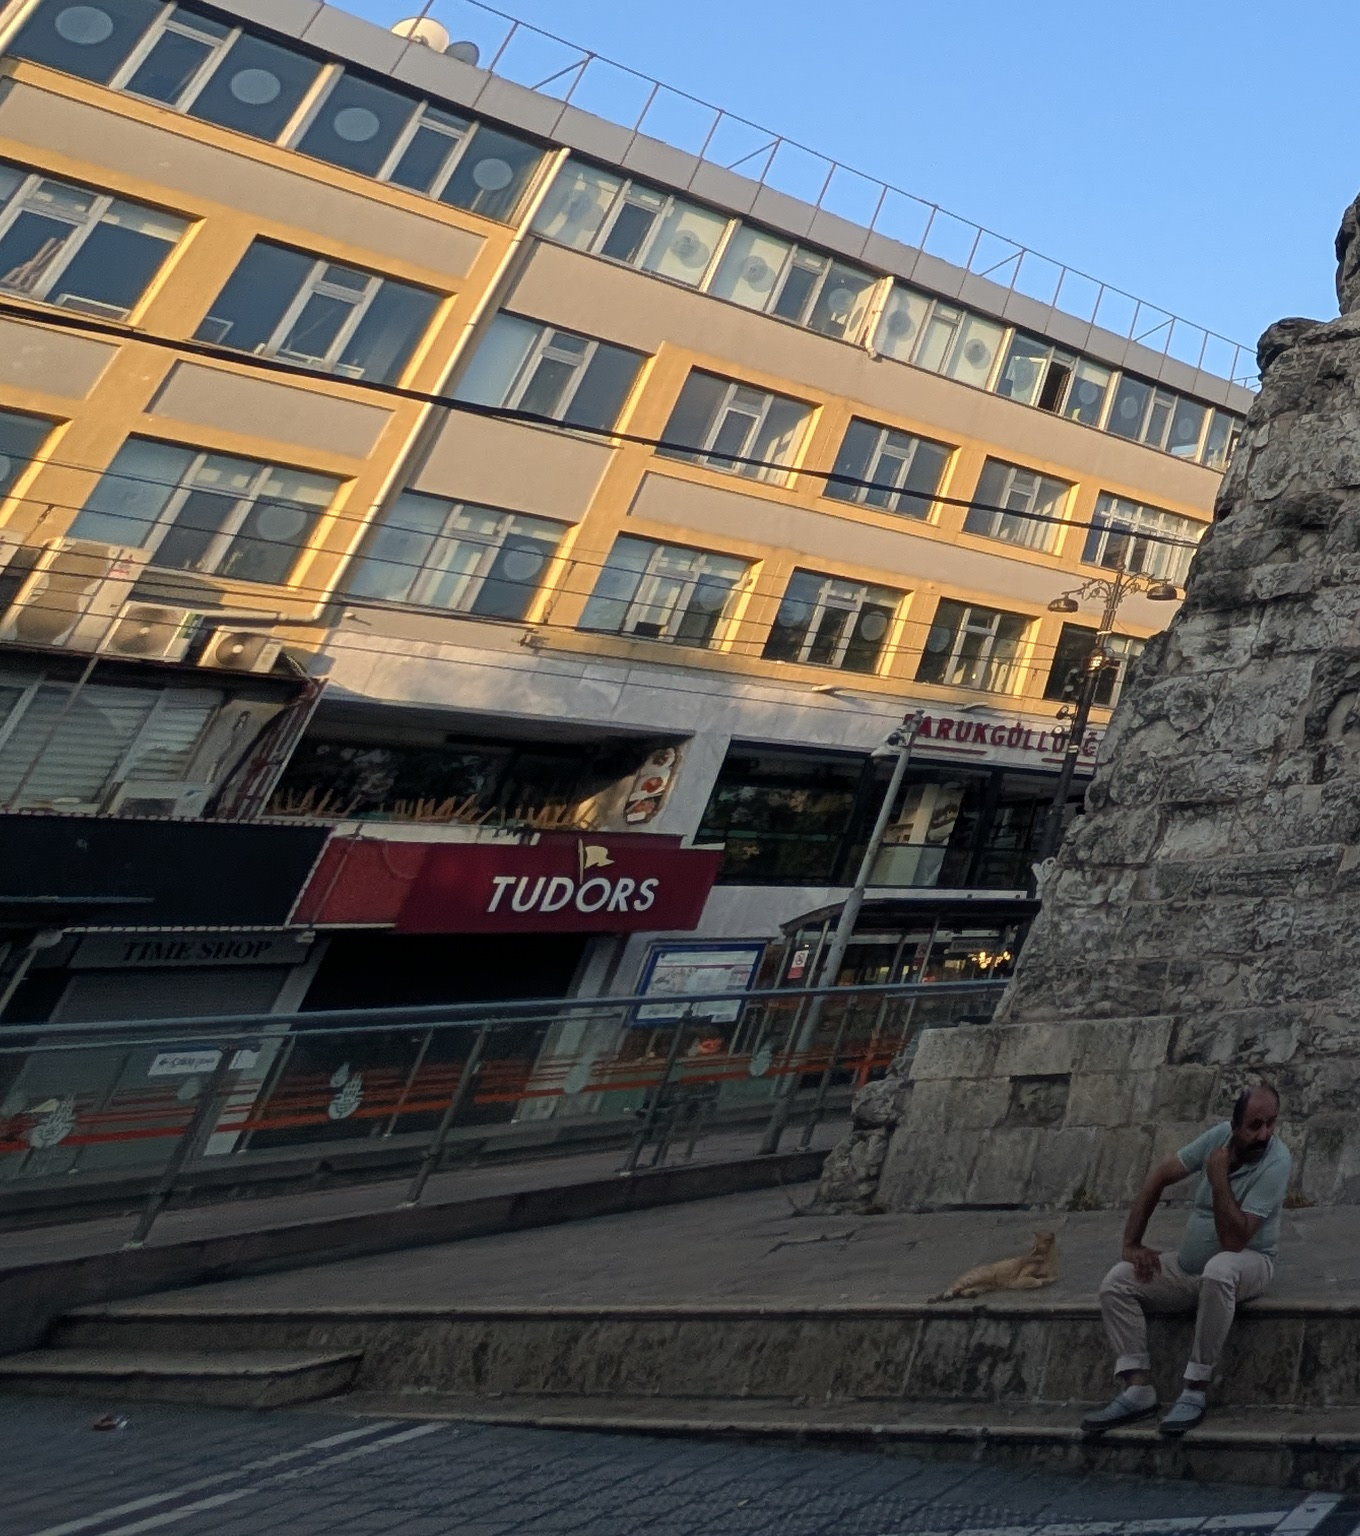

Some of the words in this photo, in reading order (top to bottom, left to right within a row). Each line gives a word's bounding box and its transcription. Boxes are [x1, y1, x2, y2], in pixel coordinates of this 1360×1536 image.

[487, 875, 660, 913] TUDORS
[124, 941, 191, 961] TIME
[197, 940, 272, 960] SHOP
